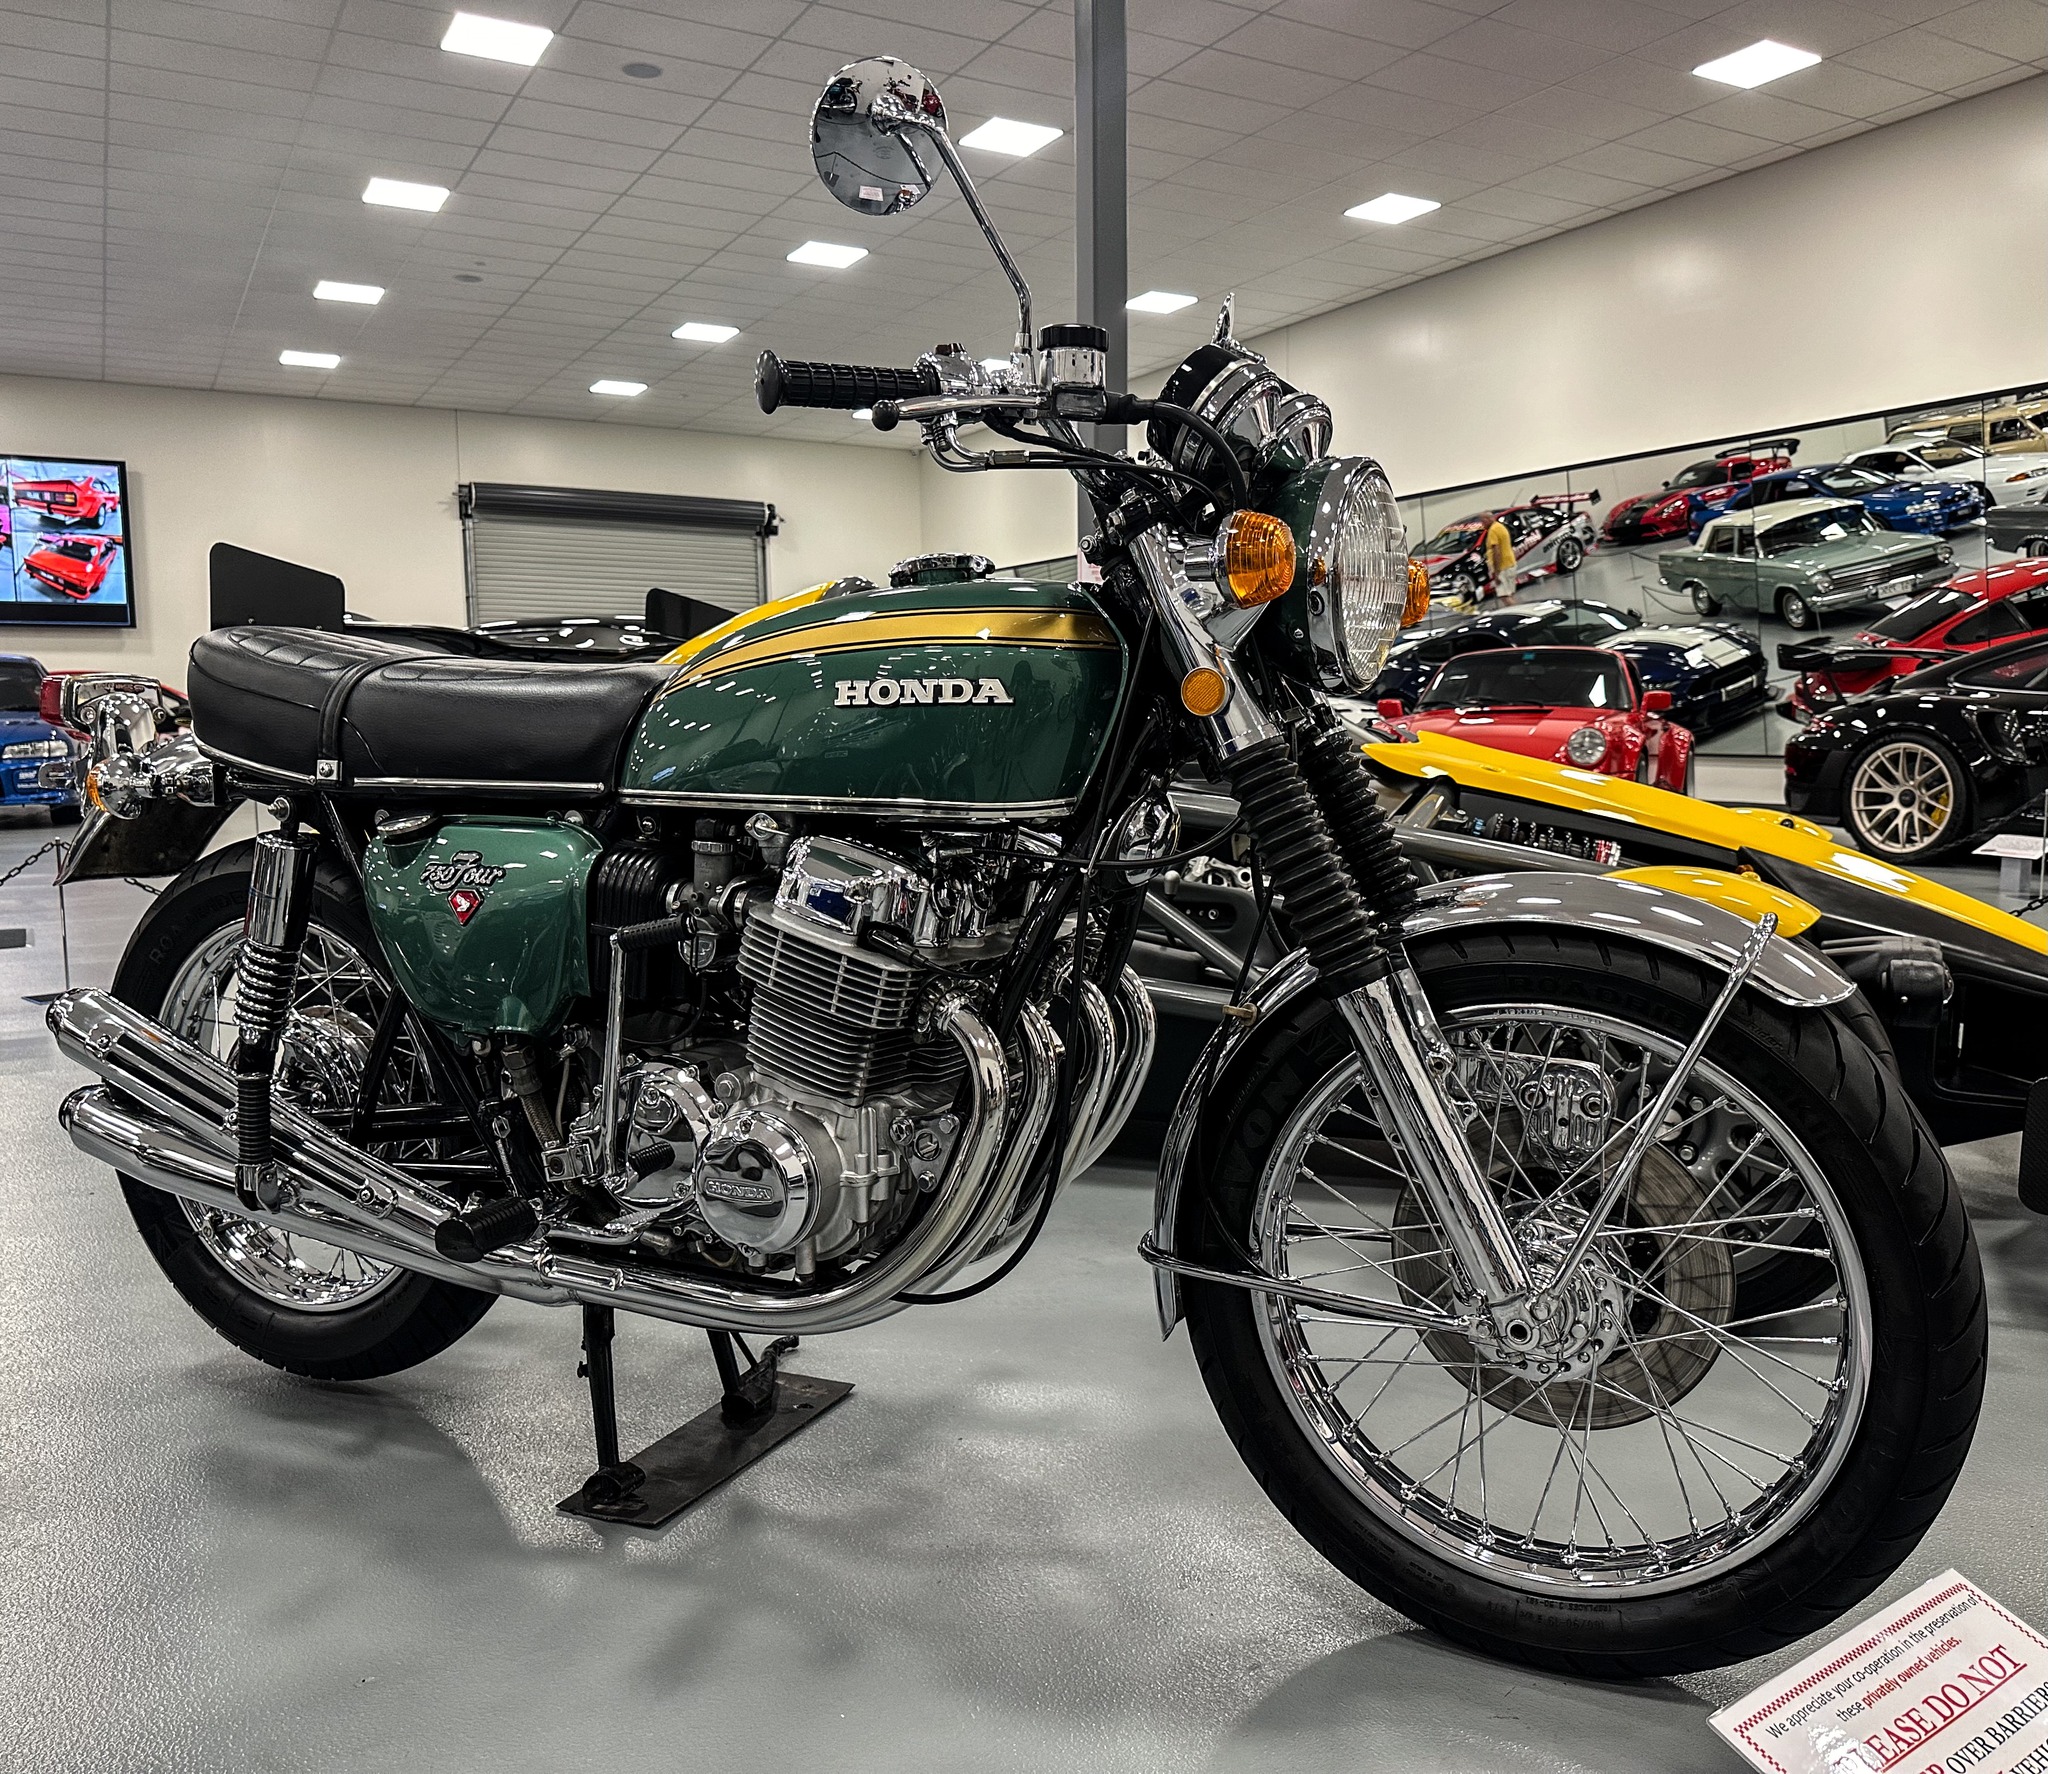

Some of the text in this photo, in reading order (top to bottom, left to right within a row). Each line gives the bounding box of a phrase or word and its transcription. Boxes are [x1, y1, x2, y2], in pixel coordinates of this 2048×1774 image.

[834, 678, 1014, 706] HONDA
[420, 852, 503, 890] 750 Four
[707, 1180, 772, 1200] HONDA
[1765, 1594, 1979, 1739] We appreciate your co-operation in the preservation of
[1835, 1636, 1963, 1722] these privately owned vehicles.
[1862, 1643, 2022, 1767] EASE DO NOT
[1945, 1736, 1997, 1774] OVER
